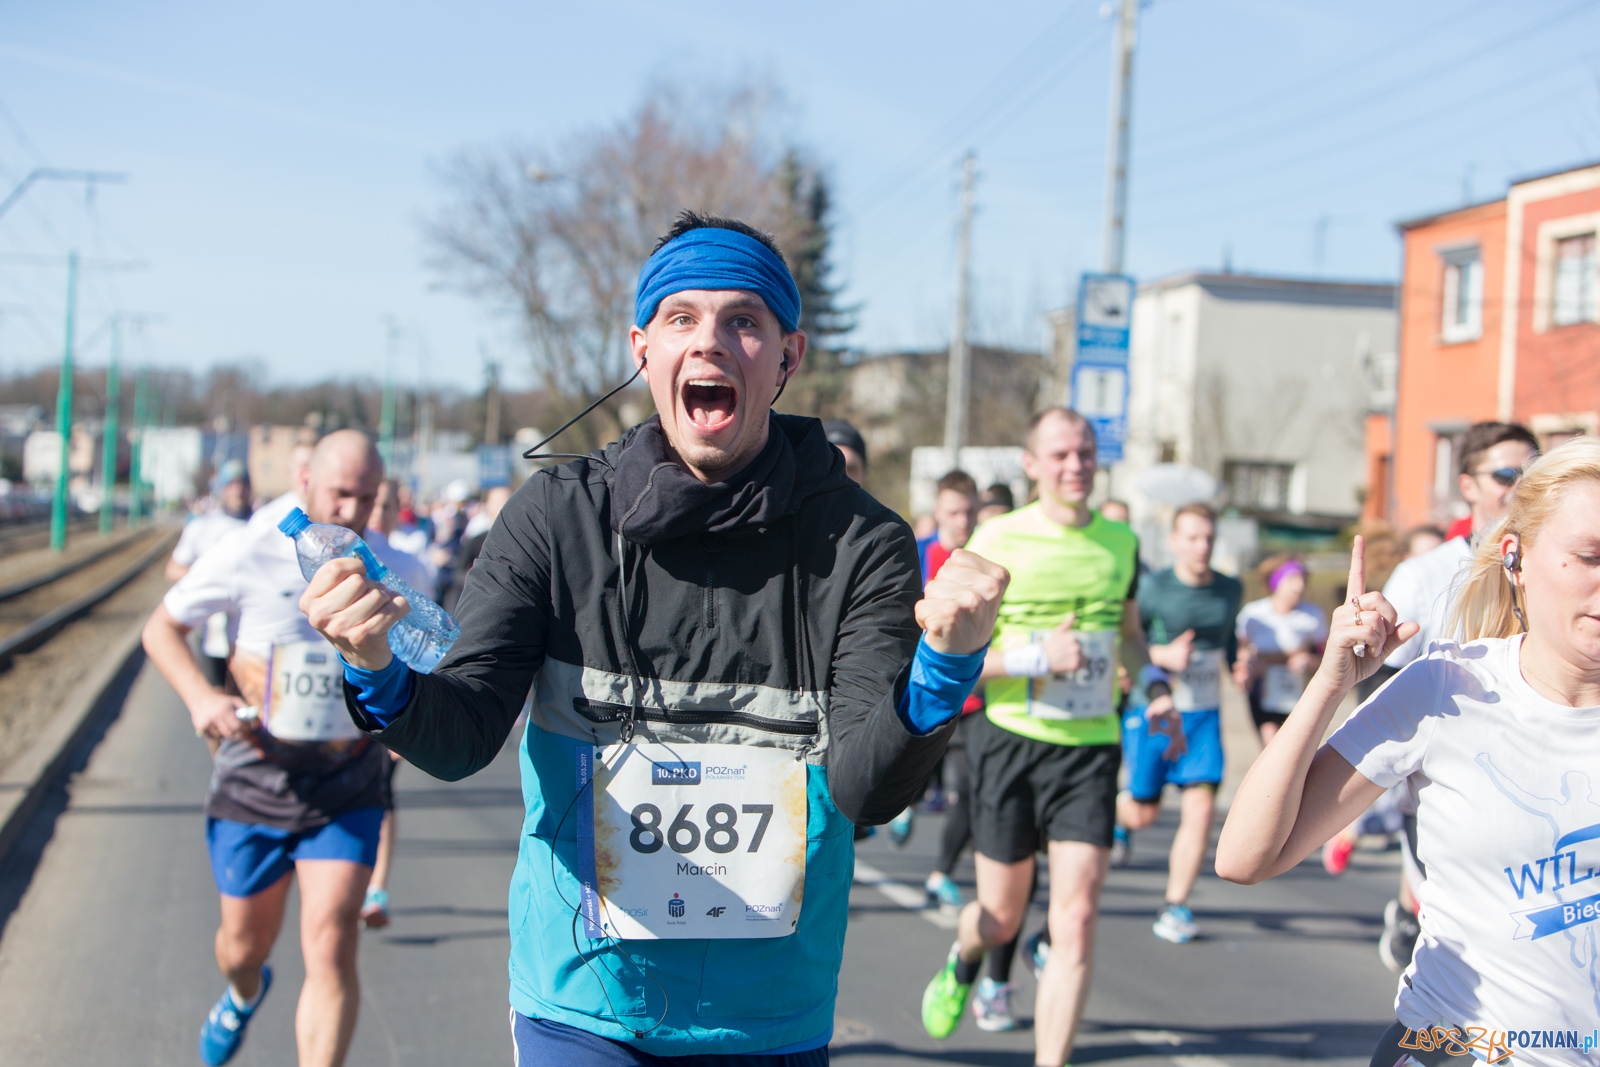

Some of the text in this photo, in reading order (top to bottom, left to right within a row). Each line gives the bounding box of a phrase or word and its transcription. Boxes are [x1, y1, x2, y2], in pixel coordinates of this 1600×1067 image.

[673, 768, 698, 779] PKO
[629, 803, 774, 854] 8687
[676, 862, 727, 876] Marcin
[1503, 850, 1600, 900] WIL
[623, 907, 649, 918] posir
[706, 906, 727, 917] 4F
